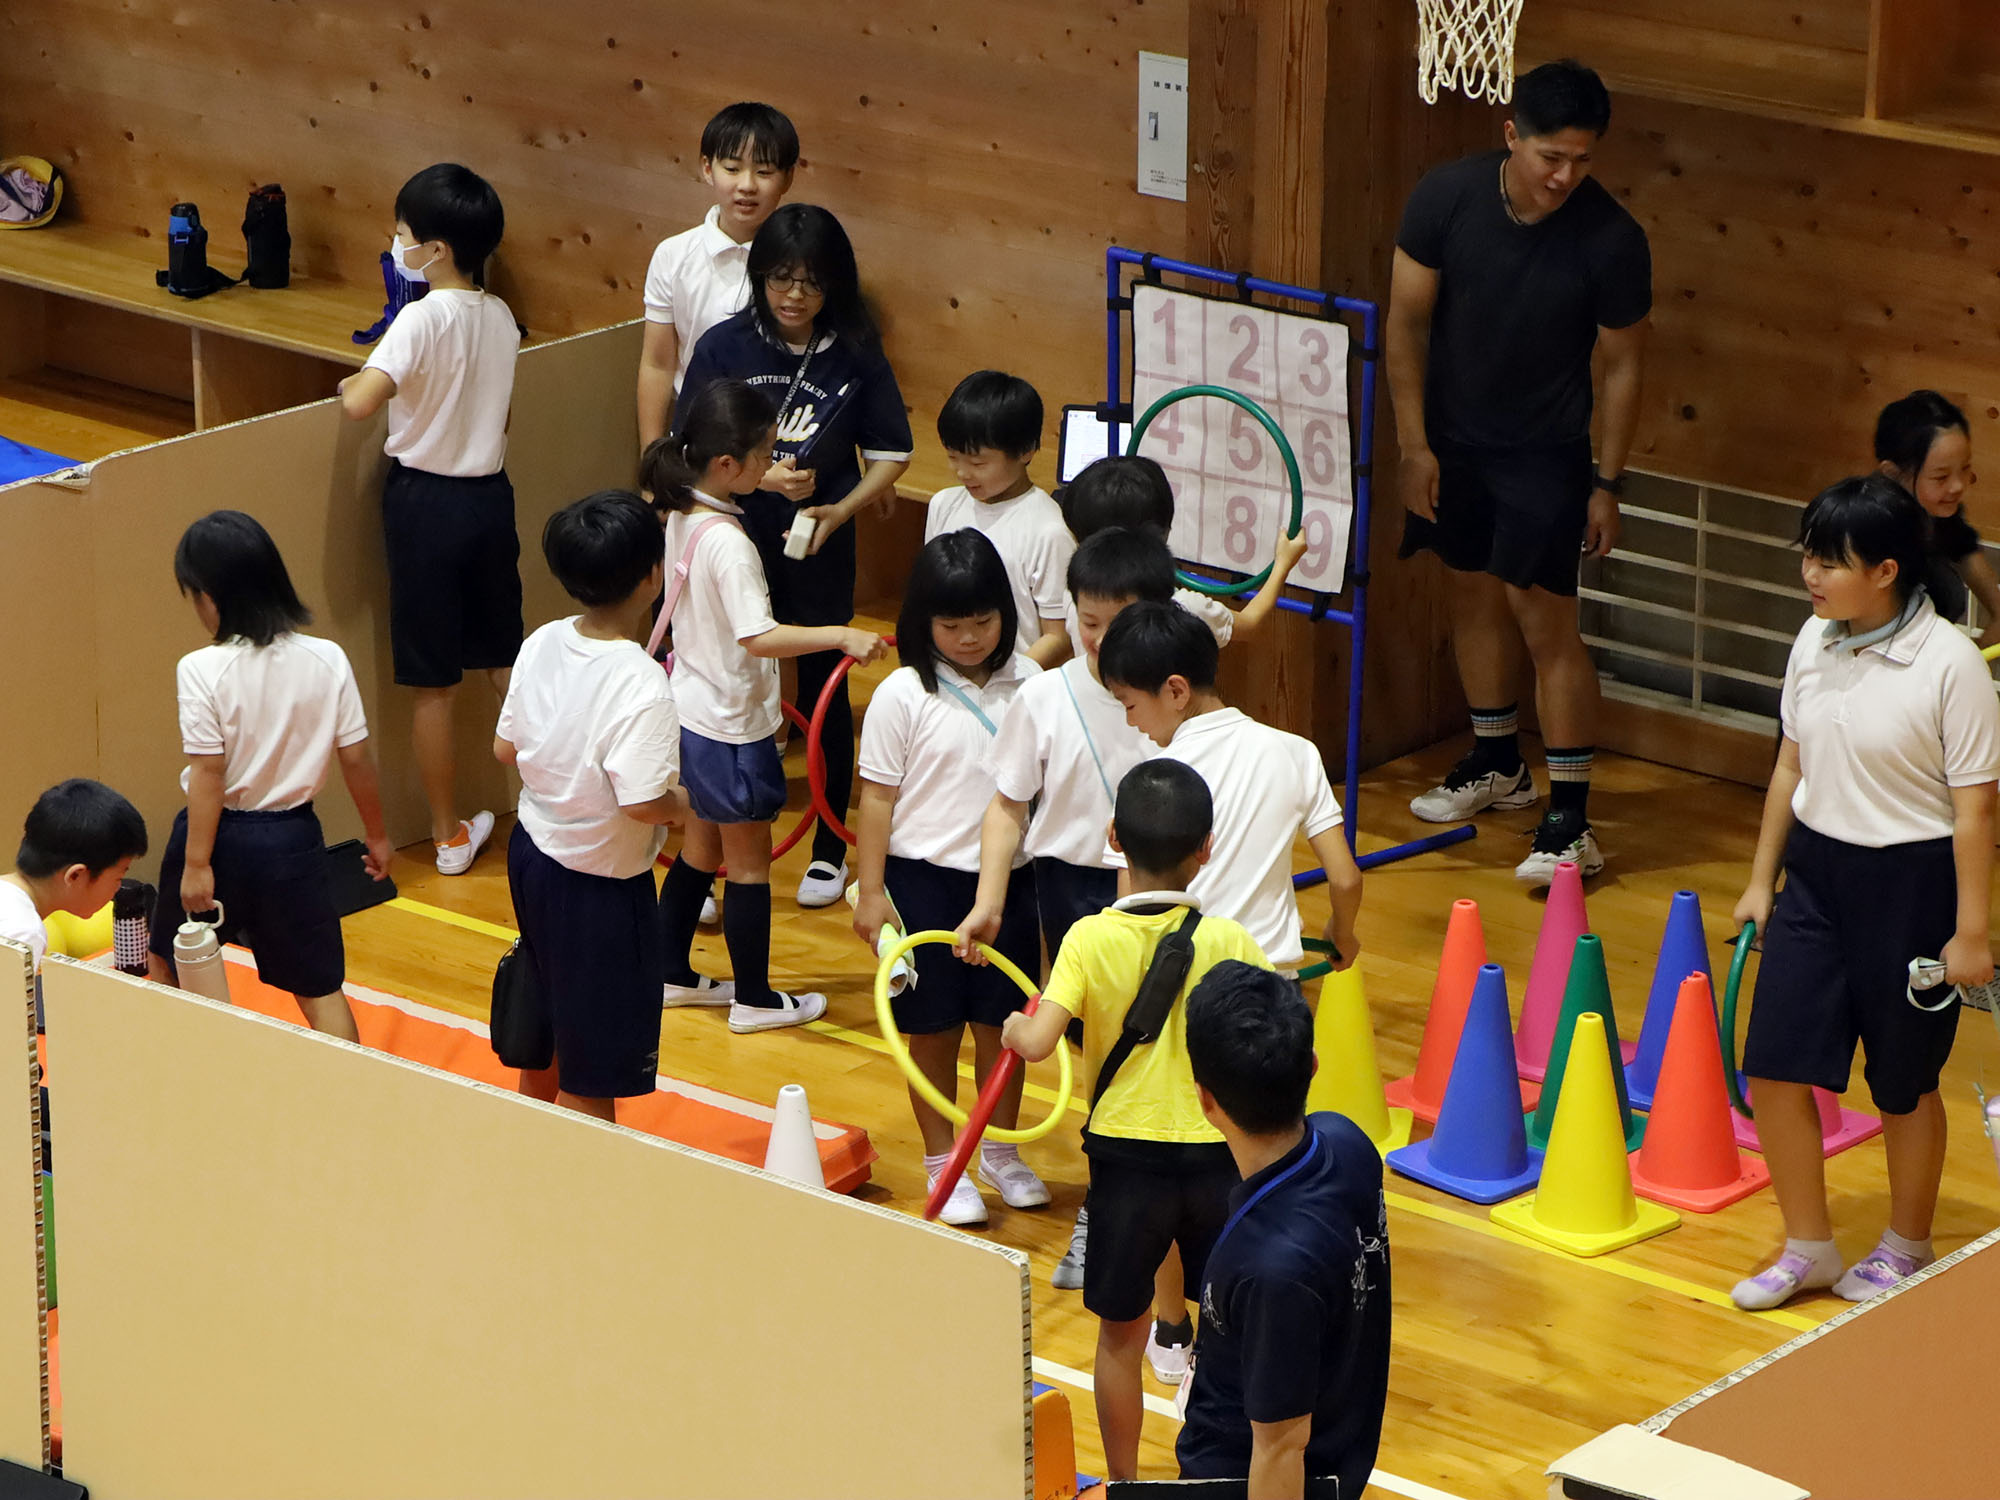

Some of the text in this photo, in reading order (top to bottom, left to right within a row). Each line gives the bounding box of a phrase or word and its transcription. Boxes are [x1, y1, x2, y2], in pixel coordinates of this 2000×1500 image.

[745, 375, 828, 400] VERYTHING PEACHY
[1153, 299, 1331, 397] 1 2 3
[1149, 403, 1335, 485] 4 5 6
[1224, 496, 1333, 579] 8 9
